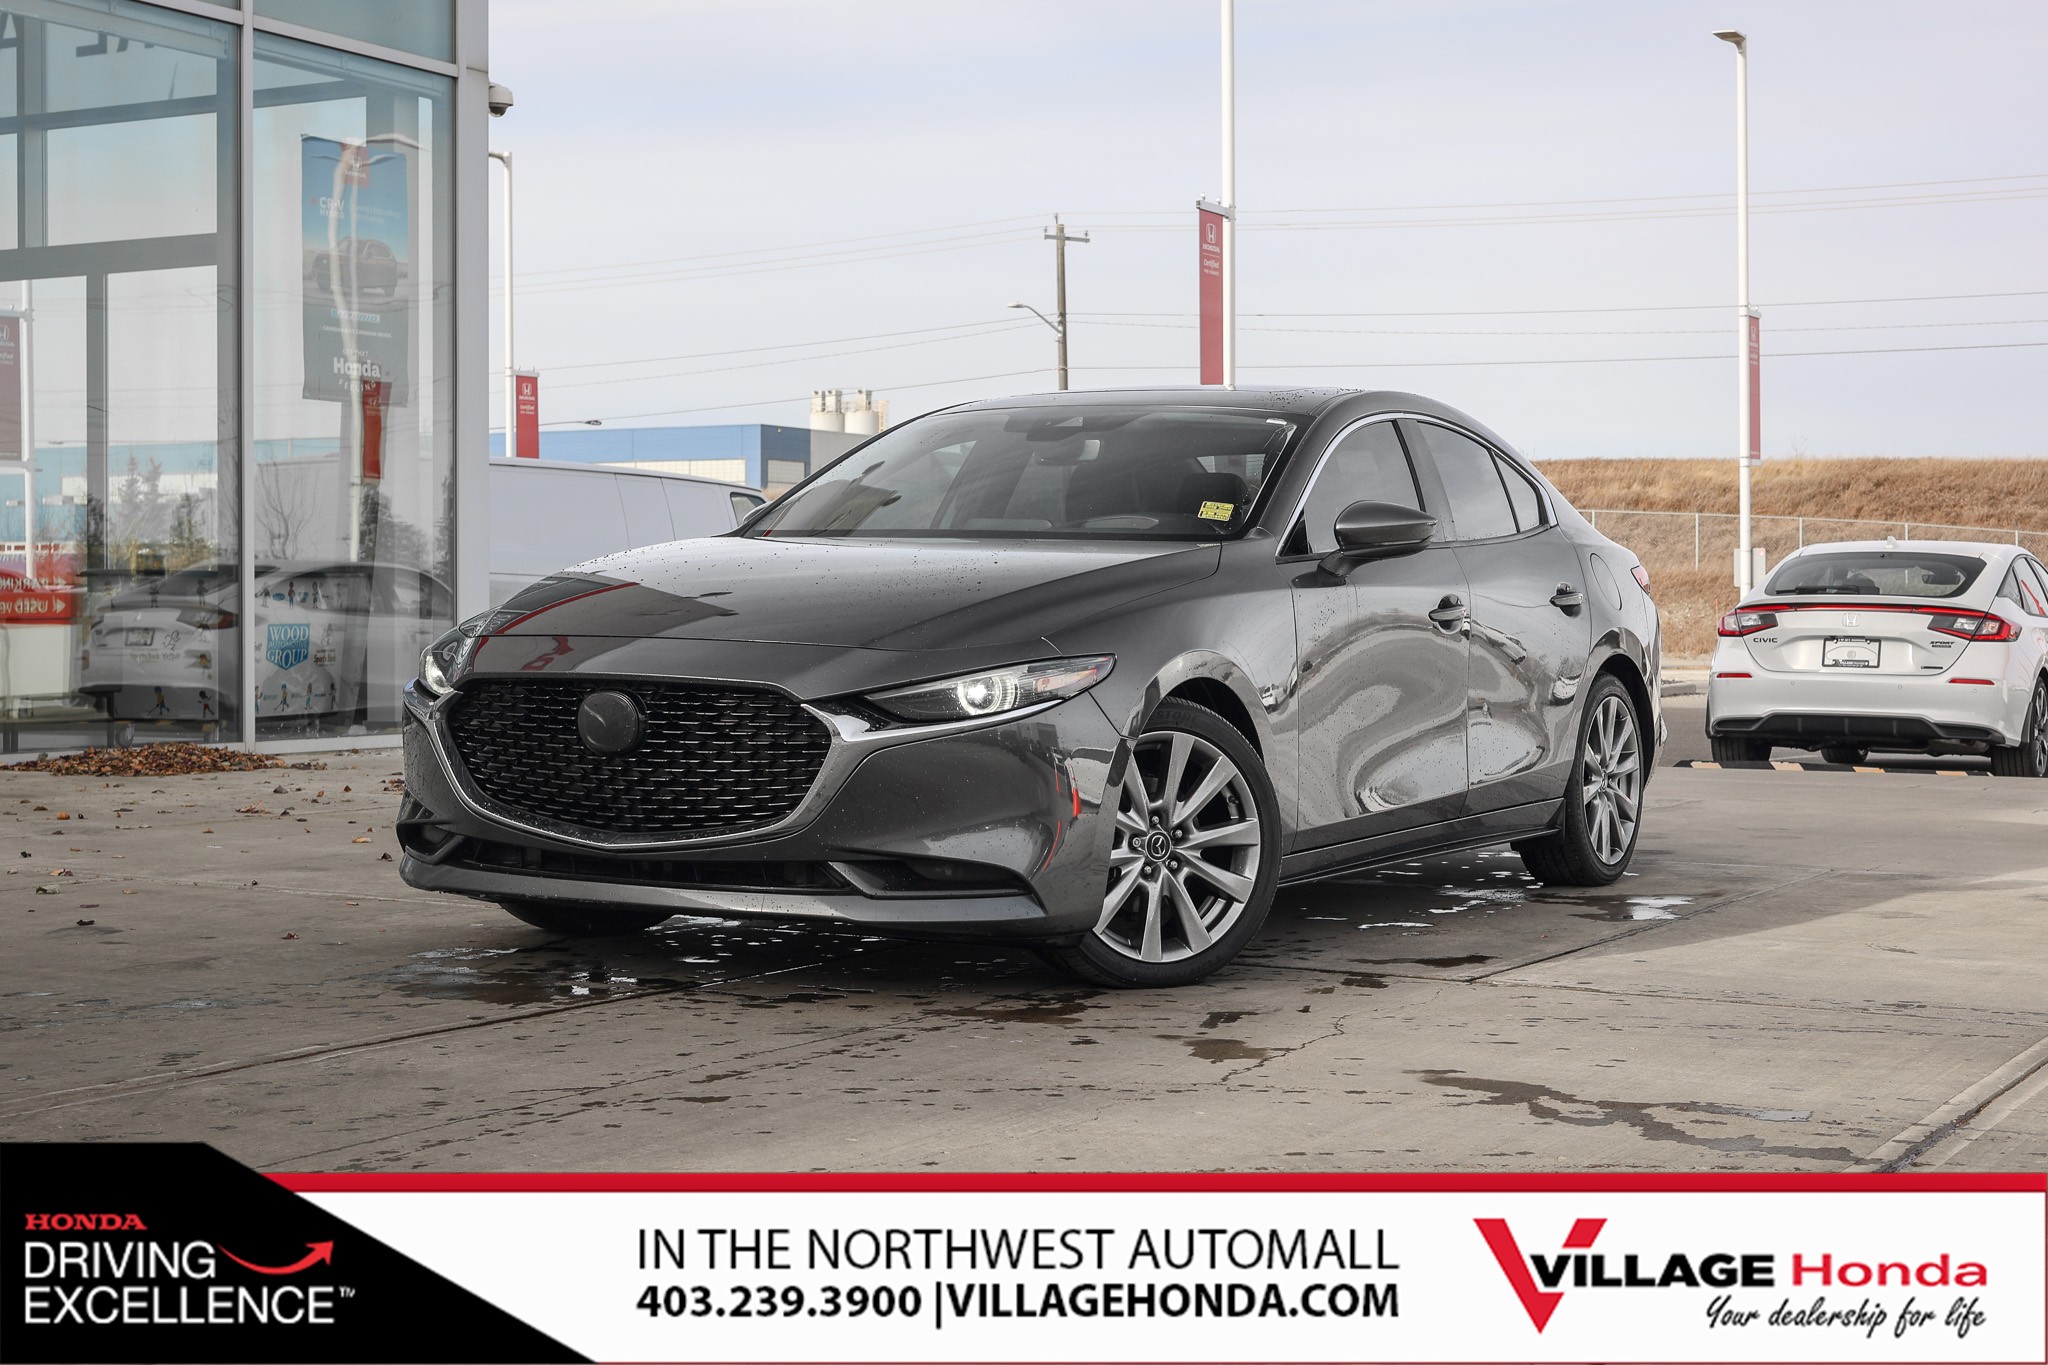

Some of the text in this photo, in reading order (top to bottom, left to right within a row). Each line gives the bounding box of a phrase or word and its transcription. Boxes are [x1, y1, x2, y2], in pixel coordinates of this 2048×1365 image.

[333, 357, 381, 378] Honda
[269, 626, 309, 641] WOOD
[267, 649, 307, 669] GROUP
